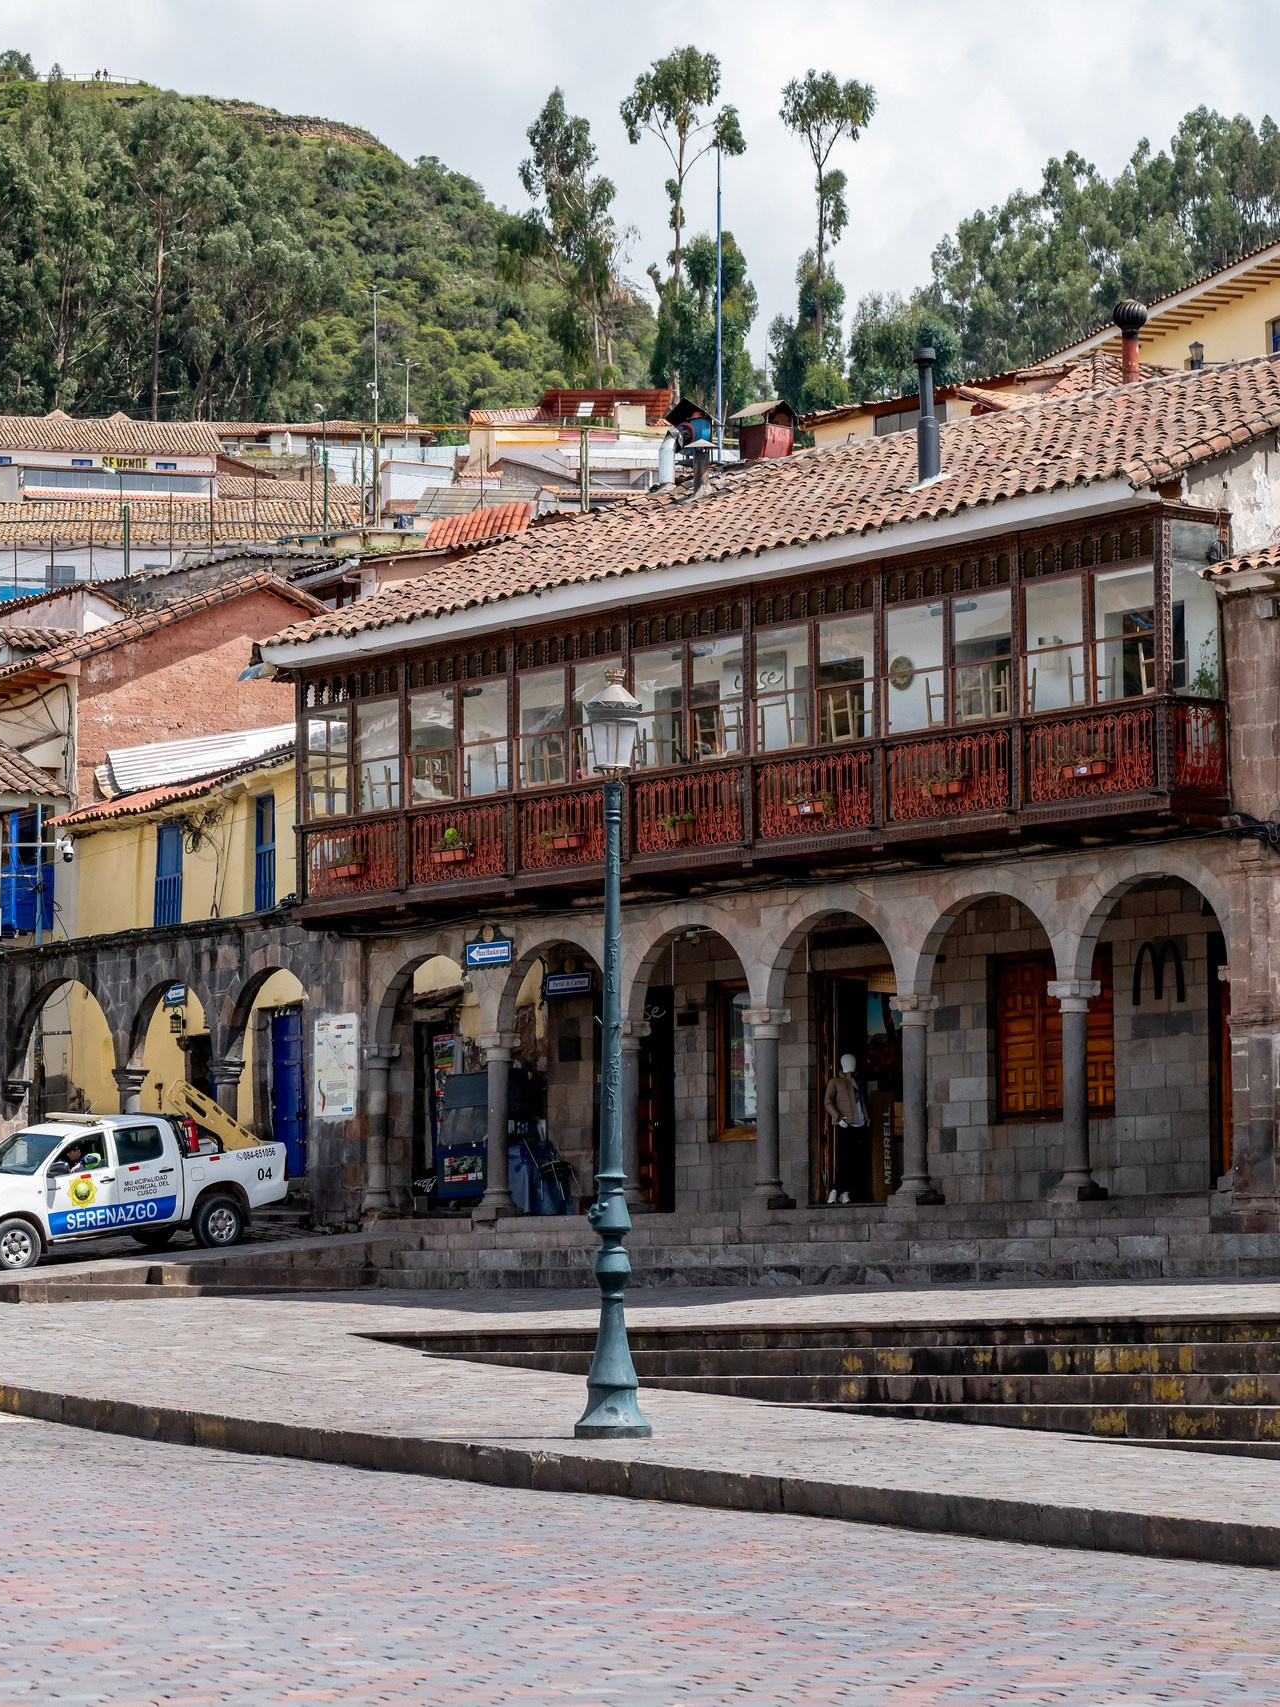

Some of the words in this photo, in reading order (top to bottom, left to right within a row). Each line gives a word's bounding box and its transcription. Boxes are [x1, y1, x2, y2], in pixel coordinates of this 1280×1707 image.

[116, 458, 148, 469] VENDE
[883, 1104, 892, 1185] MERRELL
[257, 1167, 272, 1181] 04
[123, 1182, 158, 1193] PROVINCIAL
[136, 1188, 158, 1197] CUSCO
[66, 1202, 158, 1230] SERENAZGO
